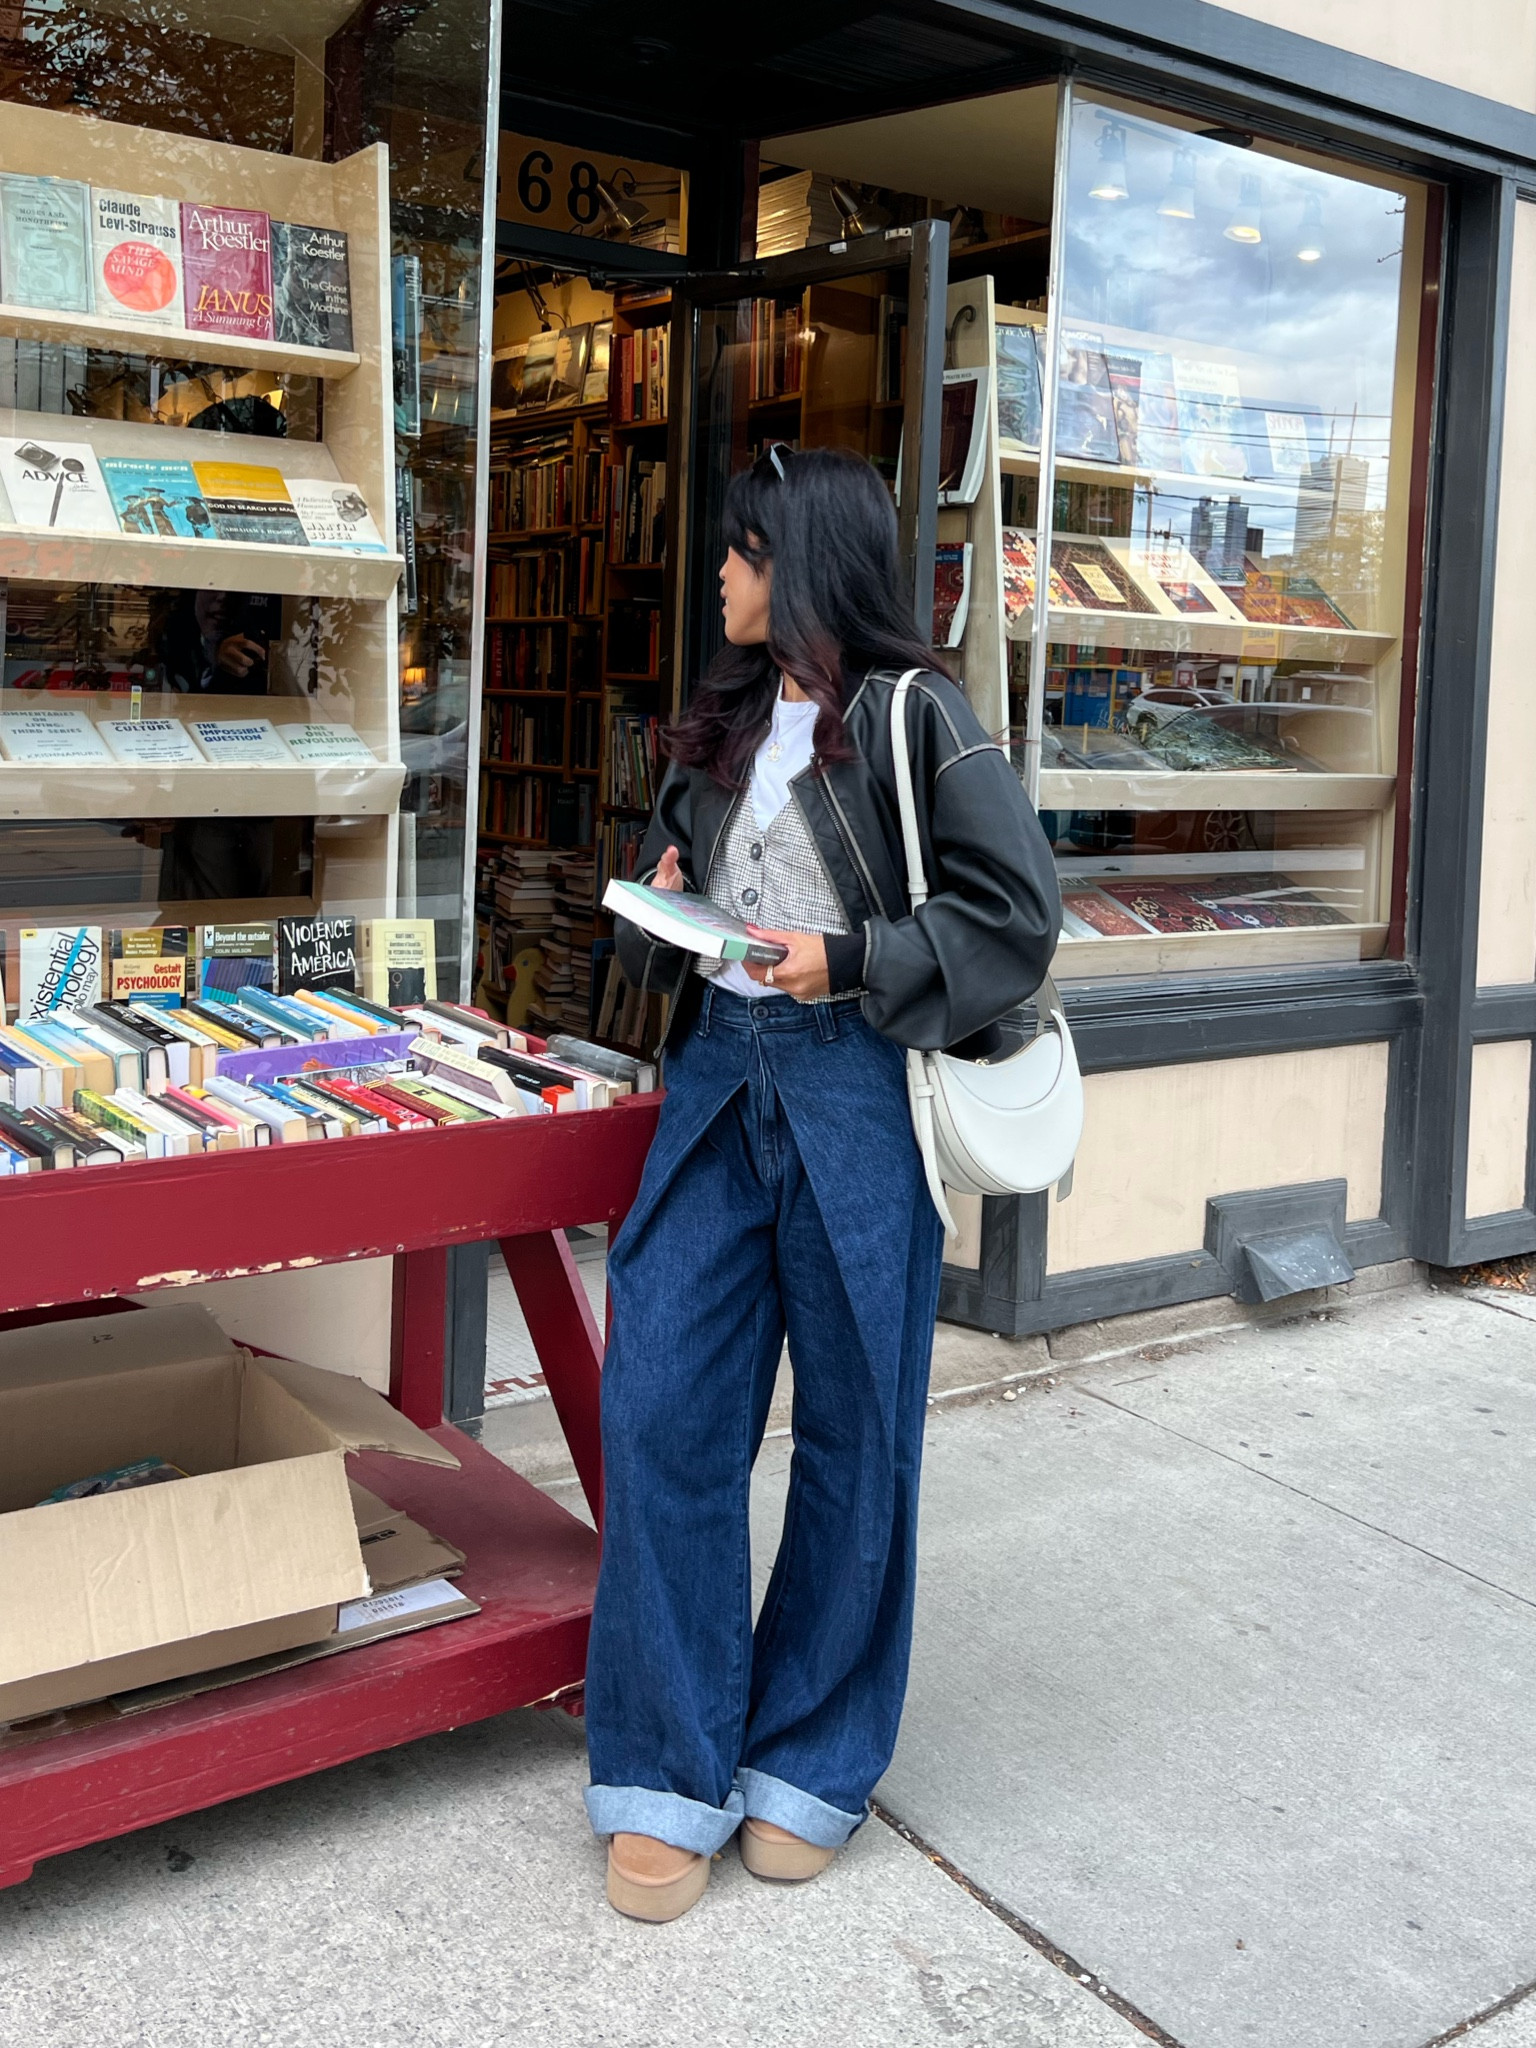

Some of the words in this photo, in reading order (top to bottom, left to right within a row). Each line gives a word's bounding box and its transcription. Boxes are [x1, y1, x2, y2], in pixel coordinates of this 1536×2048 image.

[48, 211, 65, 219] AND
[99, 199, 141, 217] Claude
[99, 215, 177, 239] Levi-Strauss
[188, 210, 252, 236] Arthur
[201, 230, 270, 253] Koestler
[309, 232, 345, 249] Arthur
[127, 245, 153, 257] THE
[302, 243, 346, 261] Koestler
[112, 253, 154, 268] SAVAGE
[111, 264, 144, 277] MIND
[302, 279, 318, 290] The
[319, 281, 348, 295] Ghost
[193, 285, 273, 317] JANUS
[325, 292, 334, 303] in
[334, 294, 348, 305] the
[309, 301, 349, 316] Machine
[193, 310, 203, 322] A
[204, 311, 256, 328] Summing
[256, 316, 272, 332] Up
[1017, 328, 1031, 338] Art
[105, 461, 157, 471] miracle
[22, 469, 89, 484] ADVICE
[207, 502, 226, 510] GOD
[237, 504, 267, 512] SEARCH
[225, 527, 260, 535] ABRAHAM
[114, 724, 174, 732] CULTURE
[195, 722, 218, 730] THE
[199, 726, 269, 737] IMPOSSIBLE
[203, 734, 263, 743] QUESTION
[289, 737, 361, 746] REVOLUTION
[215, 931, 237, 944] Beyond
[237, 931, 247, 941] the
[247, 930, 271, 941] outsider
[283, 919, 353, 949] VIOLENCE
[314, 940, 332, 957] IN
[153, 963, 182, 975] Gestalt
[291, 947, 356, 977] AMERICA
[82, 967, 99, 995] may
[116, 975, 182, 991] PSYCHOLOGY
